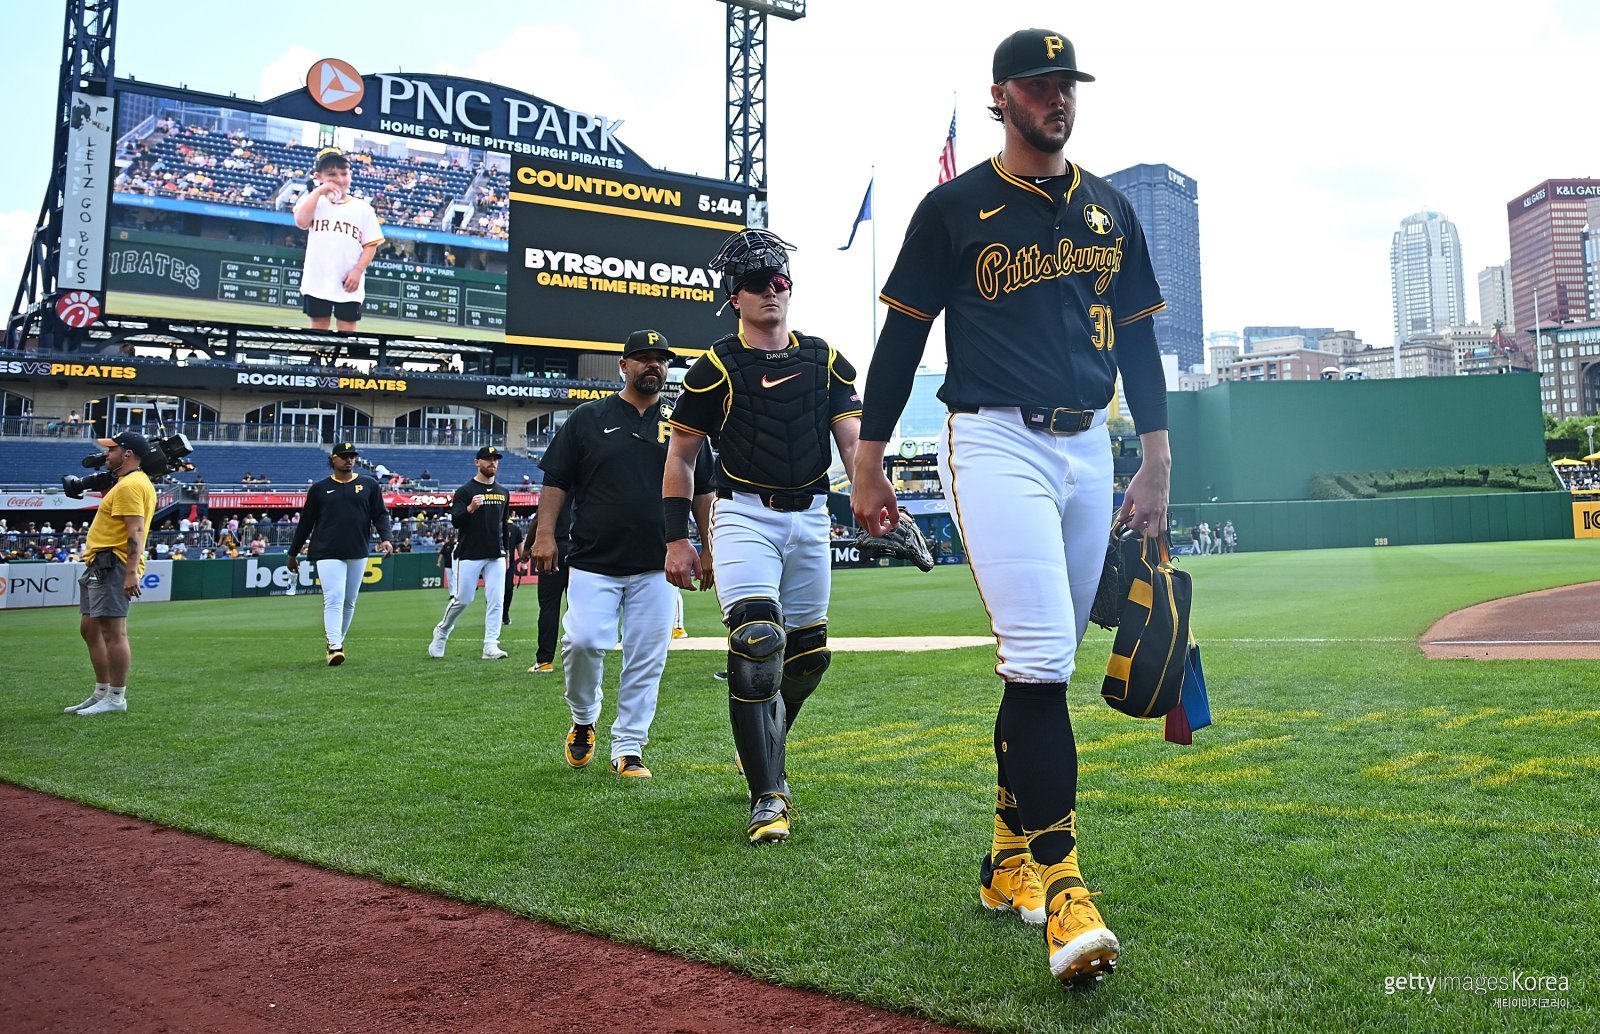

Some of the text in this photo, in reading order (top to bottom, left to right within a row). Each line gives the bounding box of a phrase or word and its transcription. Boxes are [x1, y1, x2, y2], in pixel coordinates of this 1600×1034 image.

[1044, 35, 1064, 59] P
[375, 73, 626, 155] PNC PARK
[380, 119, 624, 170] HOME OF THE PITTSBURGH PIRATES
[516, 166, 743, 217] COUNTDOWN 5:44
[1556, 186, 1575, 195] K&L
[76, 136, 97, 284] LETZ GO BUCS
[423, 266, 436, 276] PNC
[524, 248, 723, 289] BYRSON GRAY
[976, 236, 1125, 300] Pittsburgh
[536, 272, 714, 302] GAME TIME FIRST PITCH
[647, 332, 660, 345] P
[345, 442, 352, 450] P
[488, 446, 496, 454] P
[354, 484, 364, 494] P
[10, 577, 60, 594] PNC
[422, 577, 441, 588] 379
